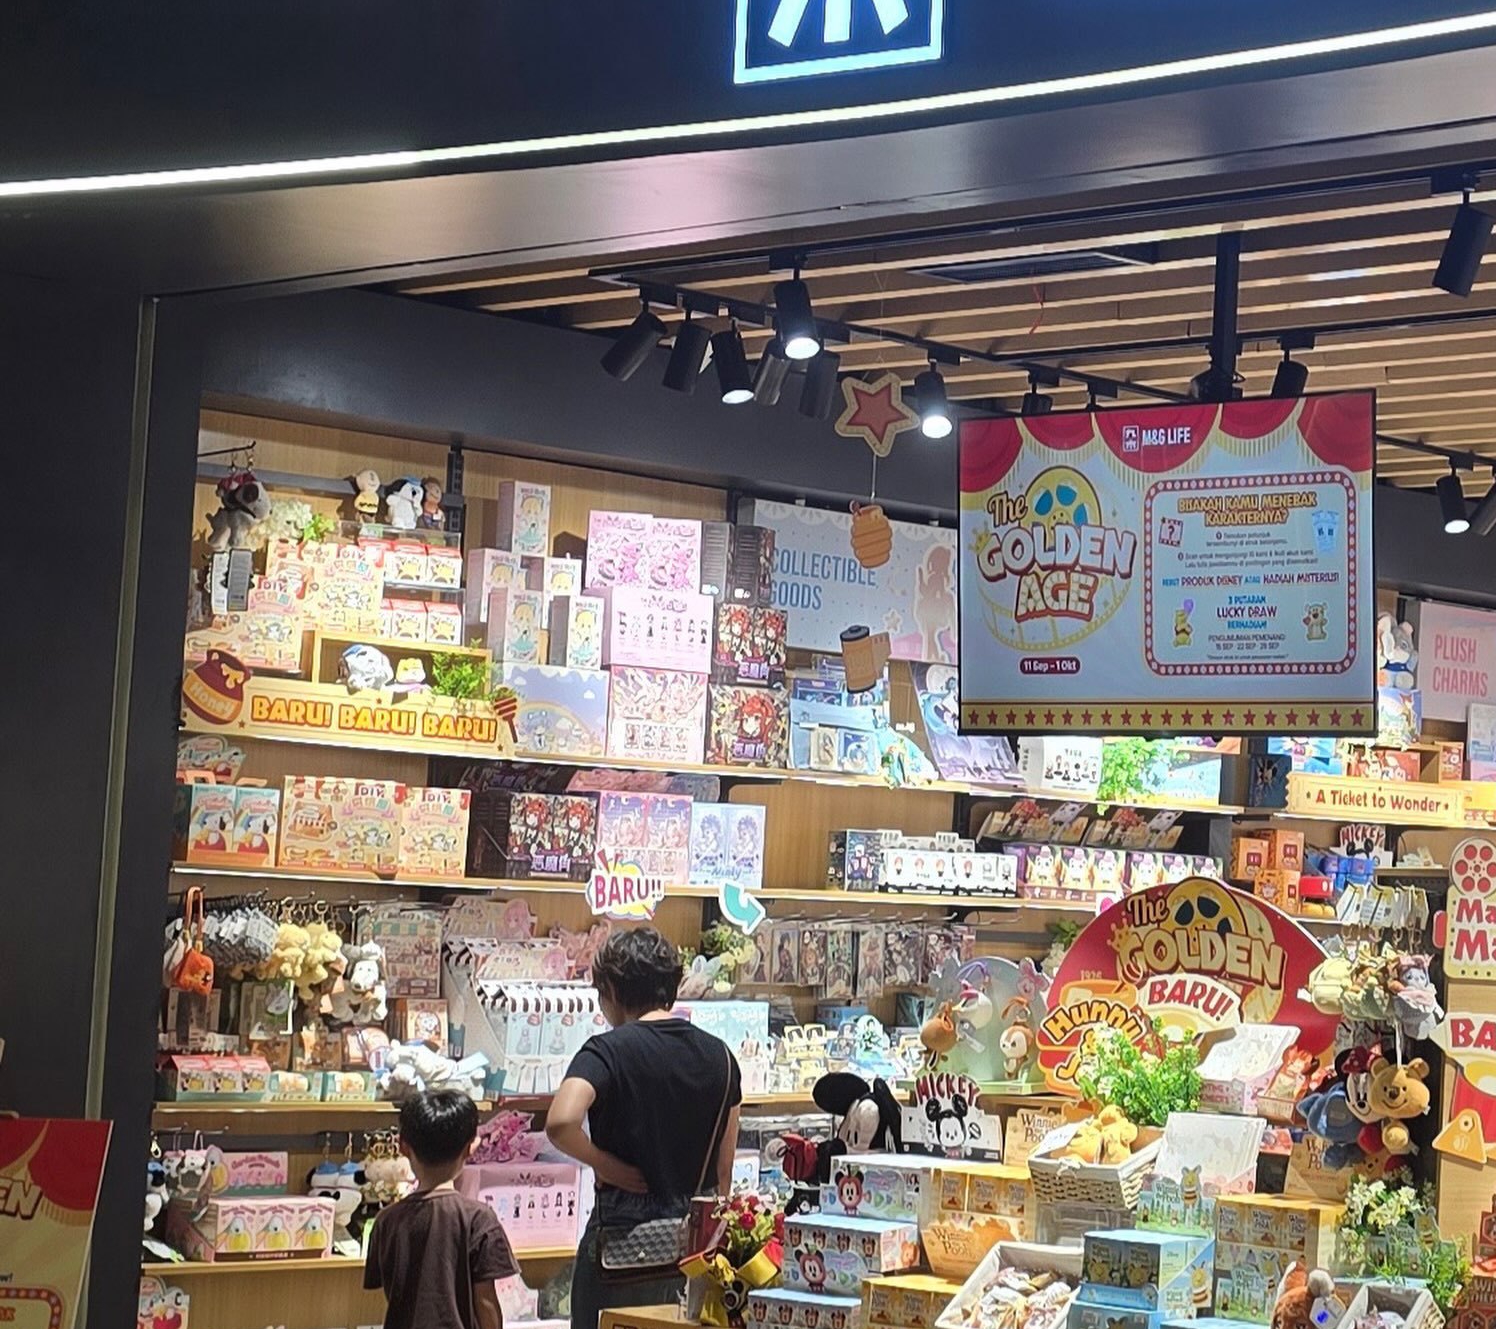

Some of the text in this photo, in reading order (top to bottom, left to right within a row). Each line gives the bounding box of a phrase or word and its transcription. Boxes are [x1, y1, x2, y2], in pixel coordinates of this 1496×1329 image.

[1142, 426, 1191, 447] M&G LIFE
[988, 491, 1029, 527] The
[1224, 495, 1259, 511] KAMU
[977, 523, 1138, 583] GOLDEN
[769, 583, 824, 611] GOODS
[1015, 570, 1099, 623] AGE
[1181, 576, 1214, 587] PRODUK
[1217, 606, 1278, 619] LUCKY DRAW
[1433, 633, 1477, 663] PLUSH
[1431, 665, 1488, 698] CHARMS
[251, 694, 499, 744] BARU! BARU! BARU!
[1316, 789, 1442, 813] A Ticket to Wonder
[1340, 823, 1386, 848] MICKEY
[594, 875, 663, 909] BARU!!
[1126, 892, 1170, 929] The
[1119, 926, 1287, 990] GOLDEN
[1148, 979, 1233, 1022] BARU!
[915, 1072, 981, 1107] MICKEY
[1022, 1113, 1059, 1130] Winnie
